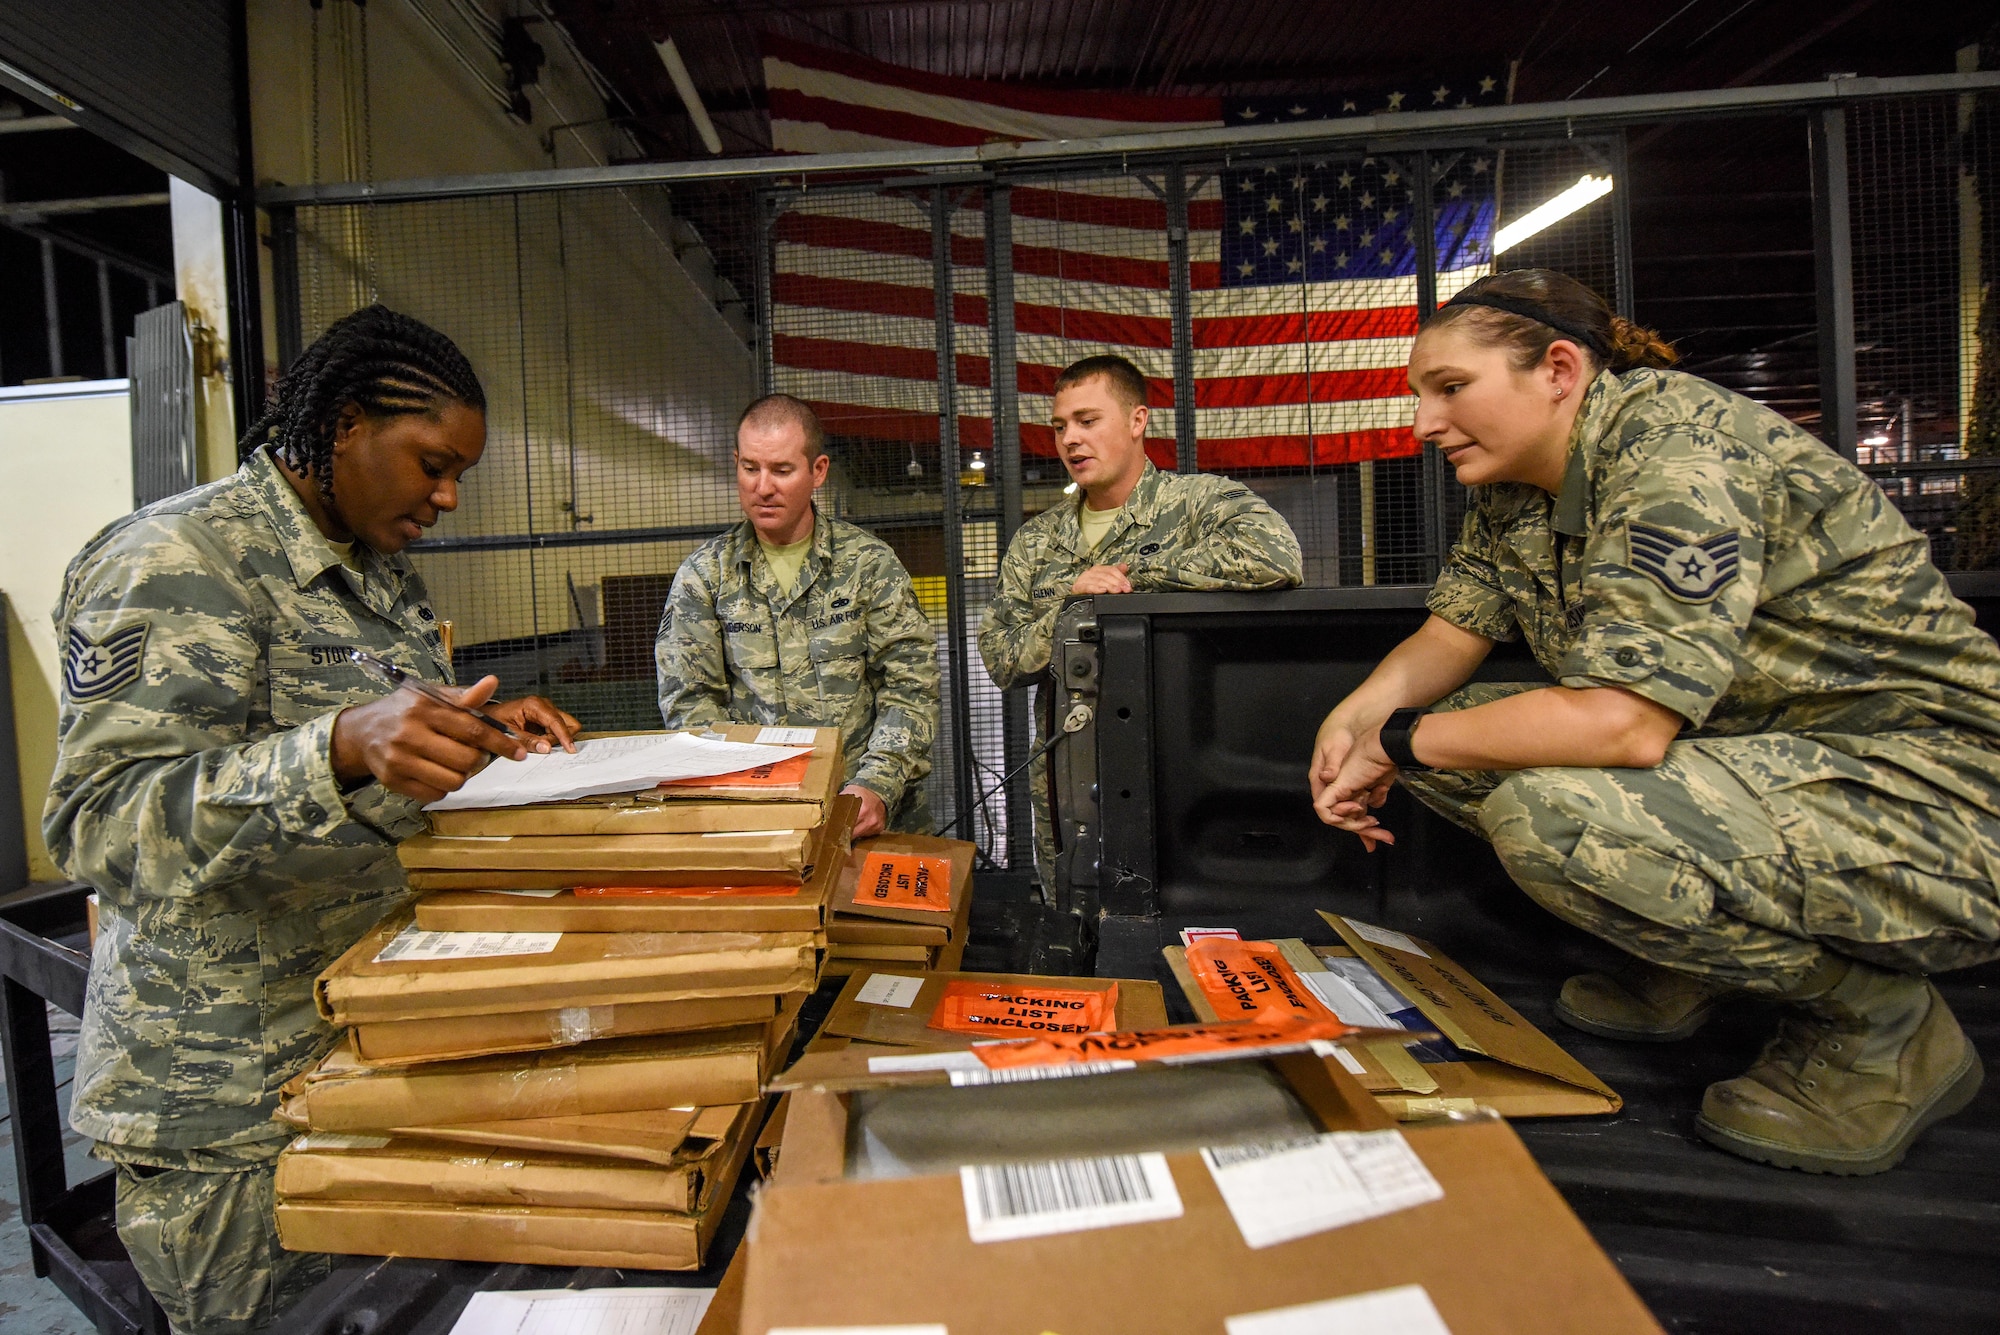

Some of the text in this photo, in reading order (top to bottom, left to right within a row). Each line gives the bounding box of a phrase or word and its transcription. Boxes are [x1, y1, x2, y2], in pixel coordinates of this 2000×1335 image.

[1033, 587, 1056, 599] GLENN
[829, 612, 844, 626] AIR
[726, 621, 761, 633] DERSON
[874, 863, 894, 899] ENCLOSED
[896, 873, 910, 890] LIST
[1241, 970, 1272, 993] LIST
[1007, 1007, 1058, 1019] LIST
